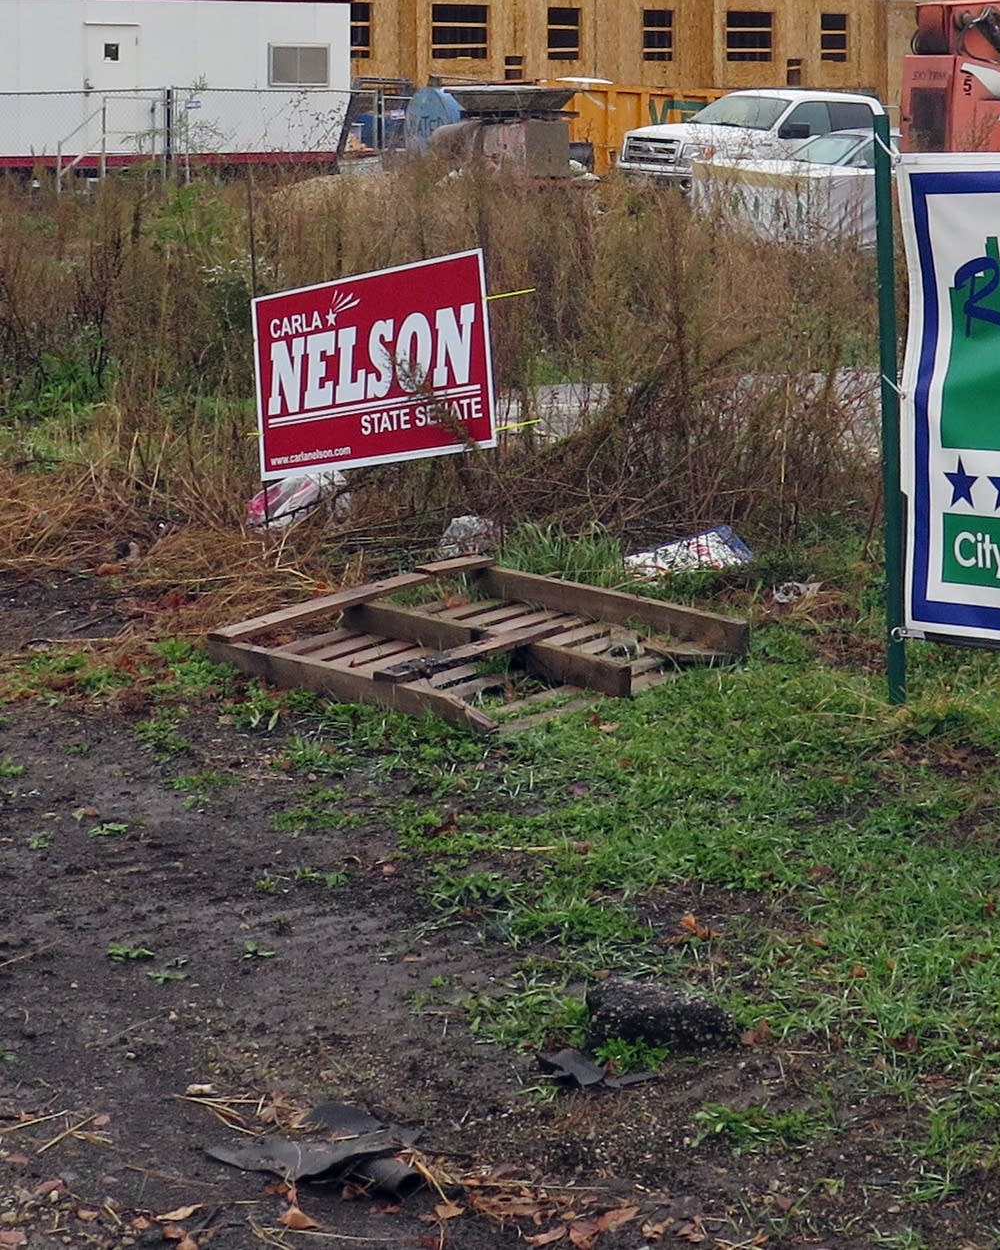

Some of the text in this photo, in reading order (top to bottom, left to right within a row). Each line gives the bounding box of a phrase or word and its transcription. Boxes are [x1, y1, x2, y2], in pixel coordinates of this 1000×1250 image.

[963, 78, 972, 92] 5
[270, 311, 322, 339] CARLA
[268, 302, 475, 416] NELSON
[361, 408, 411, 435] STATE
[270, 446, 352, 466] www.carlanelson.com
